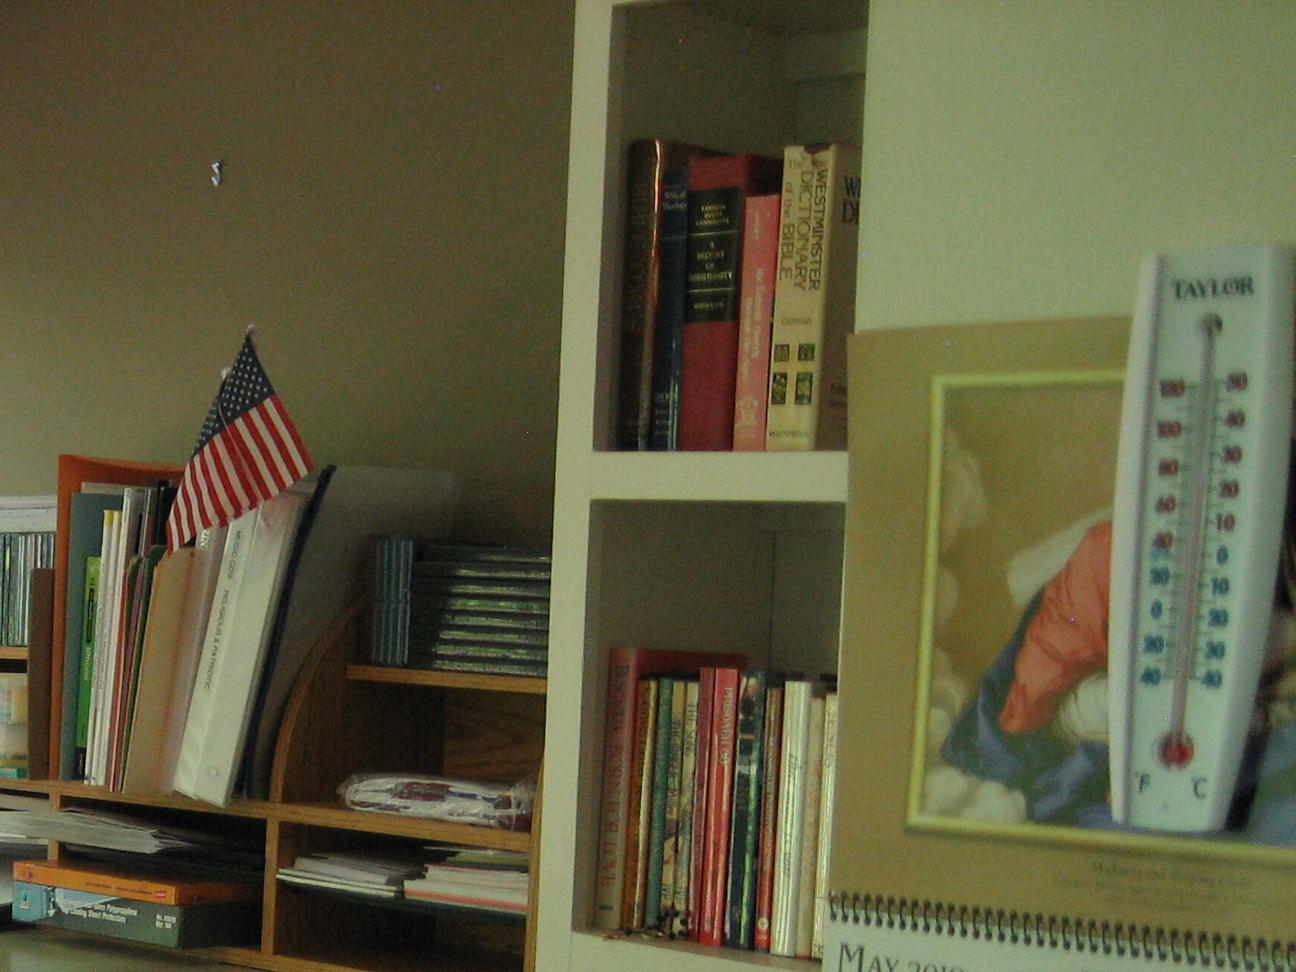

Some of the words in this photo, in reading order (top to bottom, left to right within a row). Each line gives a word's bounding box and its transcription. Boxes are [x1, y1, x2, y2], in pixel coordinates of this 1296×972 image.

[779, 222, 795, 281] BIBLE
[793, 170, 813, 290] DICTIONARY
[810, 168, 828, 291] WESTMINSTER
[1174, 276, 1254, 300] TAYLOR
[215, 589, 230, 635] RELIGIOUS
[204, 645, 219, 689] PATRIOTIC
[722, 686, 734, 746] PRISONER
[608, 745, 623, 795] BORN
[1138, 773, 1150, 793] F
[1193, 777, 1207, 799] C
[605, 801, 620, 833] FOR
[602, 841, 618, 886] LOVE
